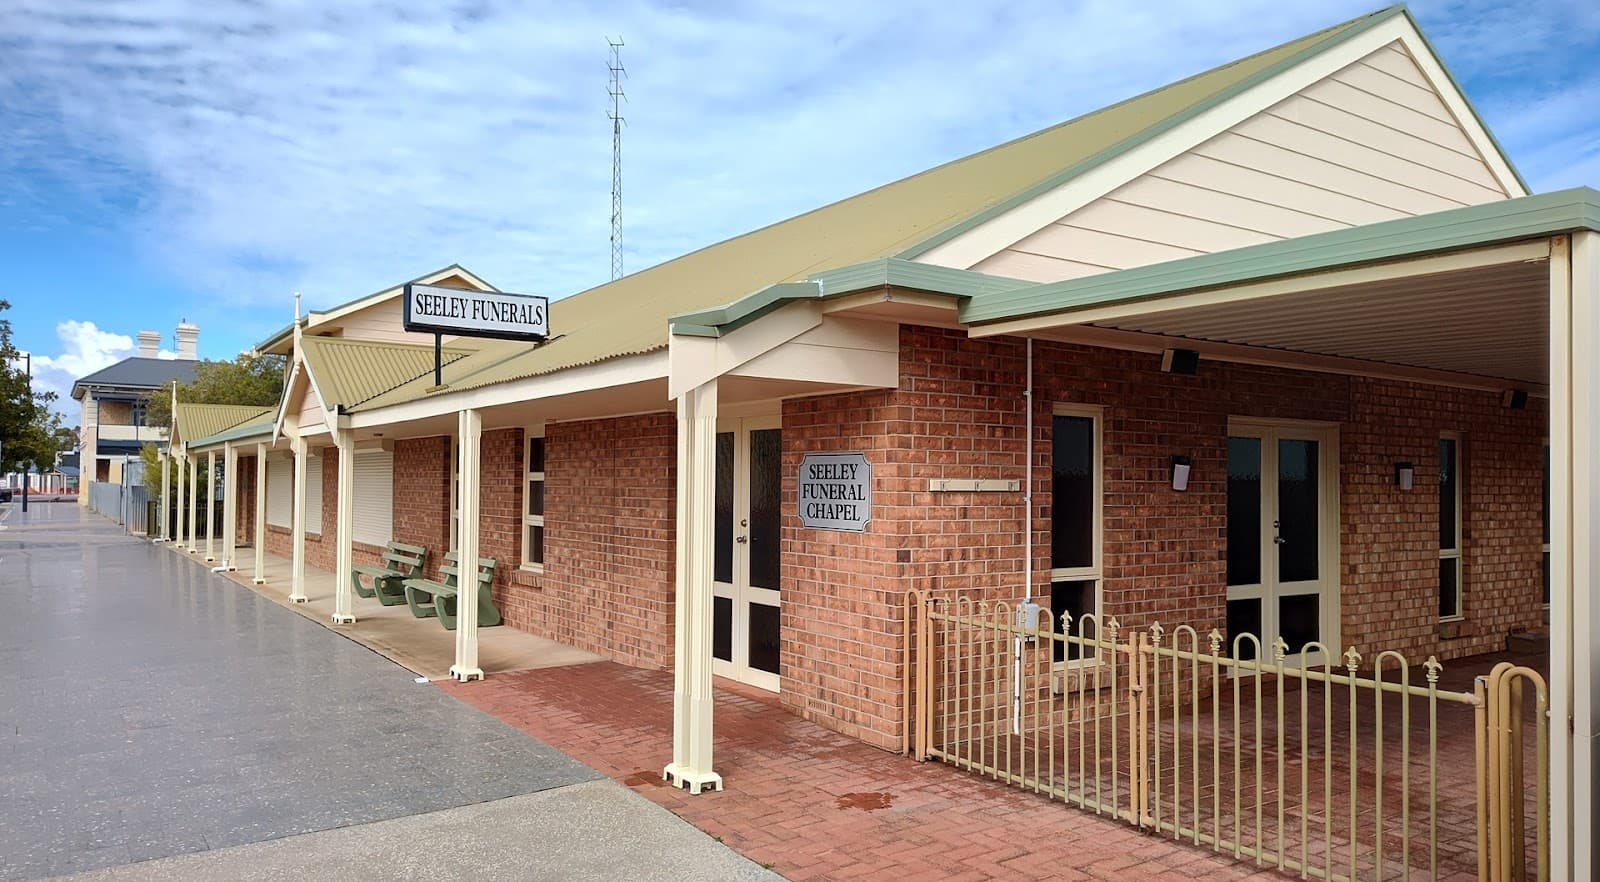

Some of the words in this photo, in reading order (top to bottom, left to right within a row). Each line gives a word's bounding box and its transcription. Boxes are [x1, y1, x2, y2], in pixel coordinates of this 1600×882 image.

[415, 293, 469, 319] SEELEY
[472, 299, 543, 326] FUNERALS
[809, 463, 859, 480] SEELEY
[802, 483, 866, 501] FUNERAL
[806, 502, 861, 521] CHAPEL
